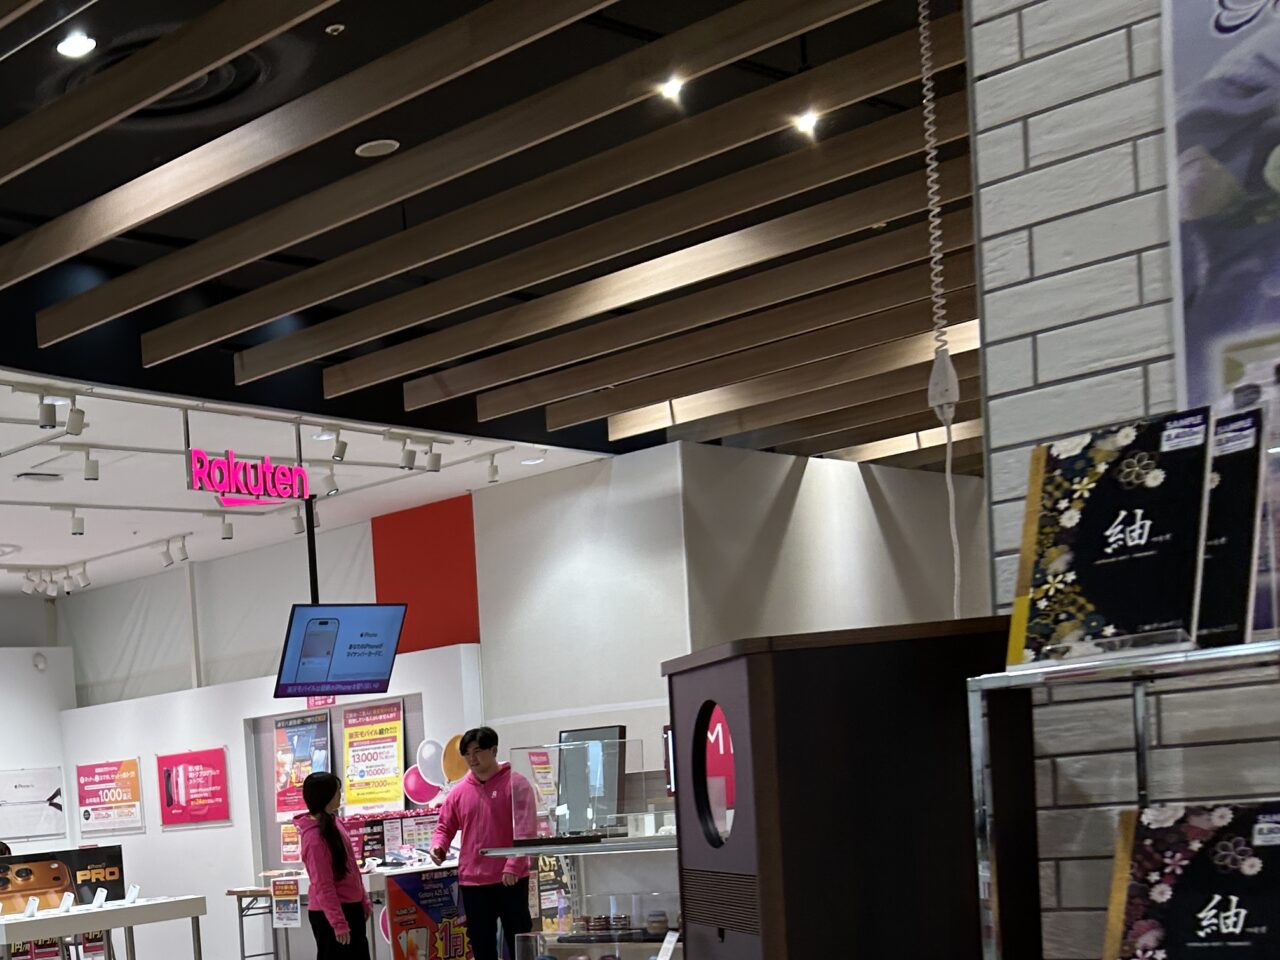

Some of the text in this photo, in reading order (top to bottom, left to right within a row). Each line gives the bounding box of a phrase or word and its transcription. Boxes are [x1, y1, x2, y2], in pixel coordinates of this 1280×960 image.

[190, 447, 309, 500] Rakuten
[1104, 508, 1153, 554] 紬
[76, 866, 120, 885] PRO
[1195, 894, 1248, 938] 紬
[439, 921, 464, 960] 1円
